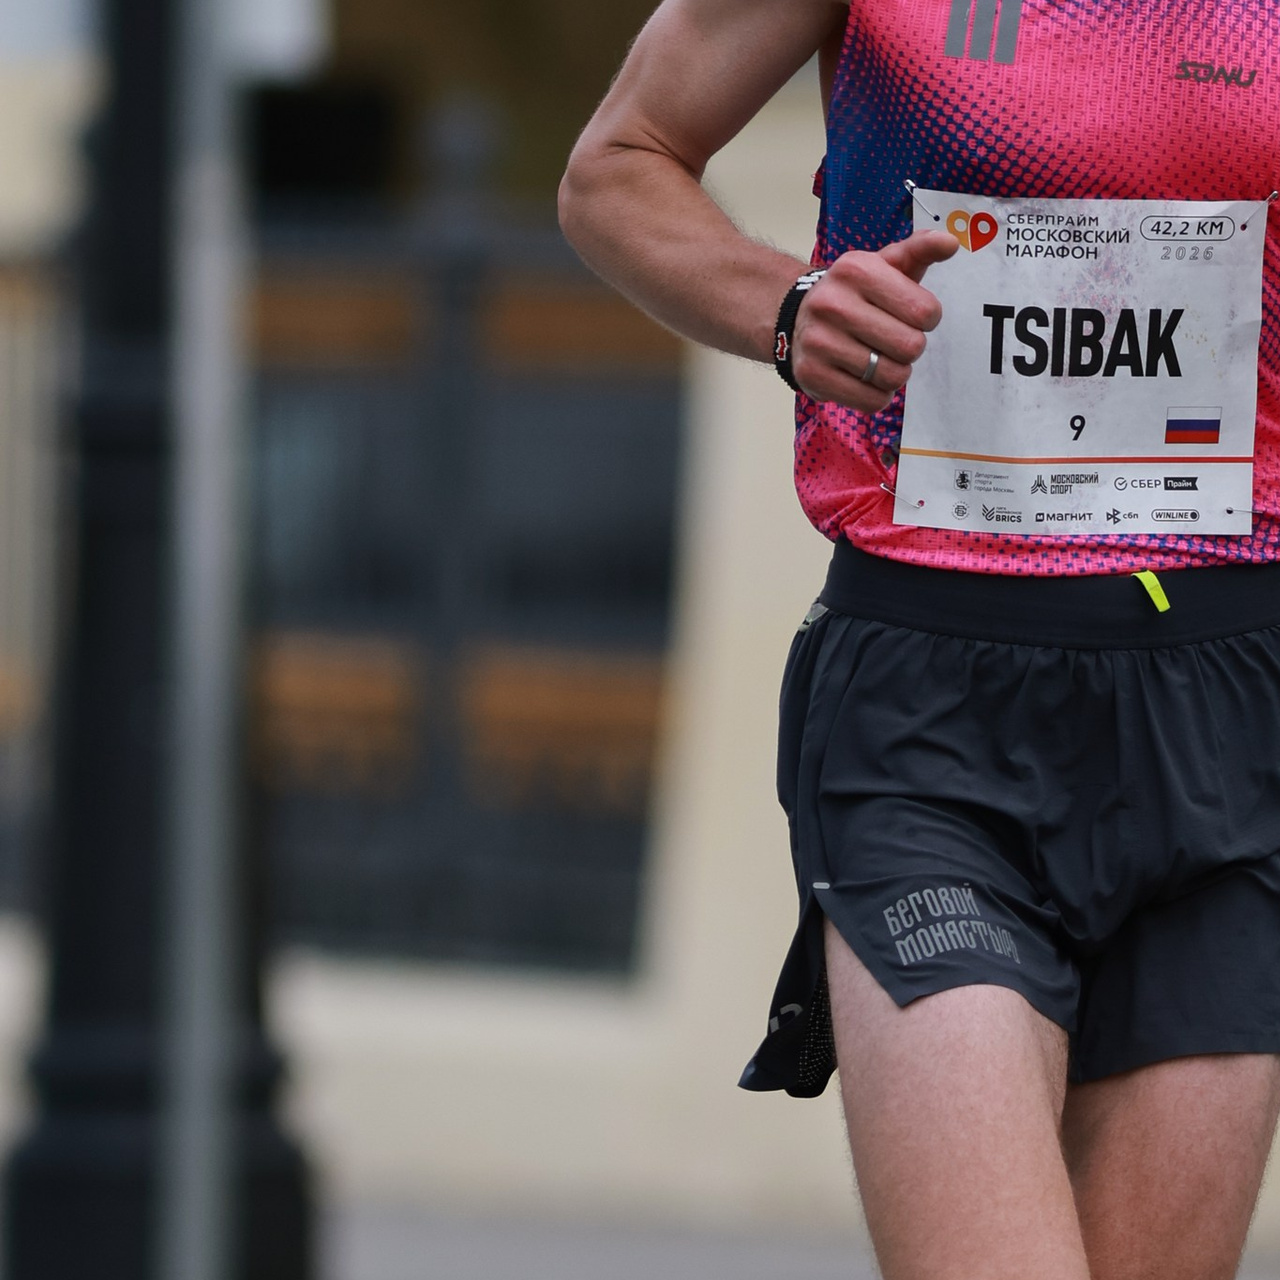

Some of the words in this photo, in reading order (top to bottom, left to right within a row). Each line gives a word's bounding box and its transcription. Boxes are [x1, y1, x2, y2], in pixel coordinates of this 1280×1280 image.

[1006, 213, 1099, 227] СБЕРПРАЙМ
[1006, 227, 1131, 244] МОСКОВСКИЙ
[1150, 221, 1190, 237] 42,2
[1006, 244, 1098, 260] МАРАФОН
[1161, 246, 1214, 260] 2026
[983, 304, 1185, 377] TSIBAK
[1069, 415, 1086, 441] 9
[1050, 472, 1099, 484] МОСКОВСКИЙ
[1131, 480, 1161, 488] СБЕР
[1167, 480, 1192, 488] Прайм
[1050, 485, 1073, 494] СПОРТ
[995, 515, 1022, 523] BRICS
[1046, 512, 1093, 521] магнит
